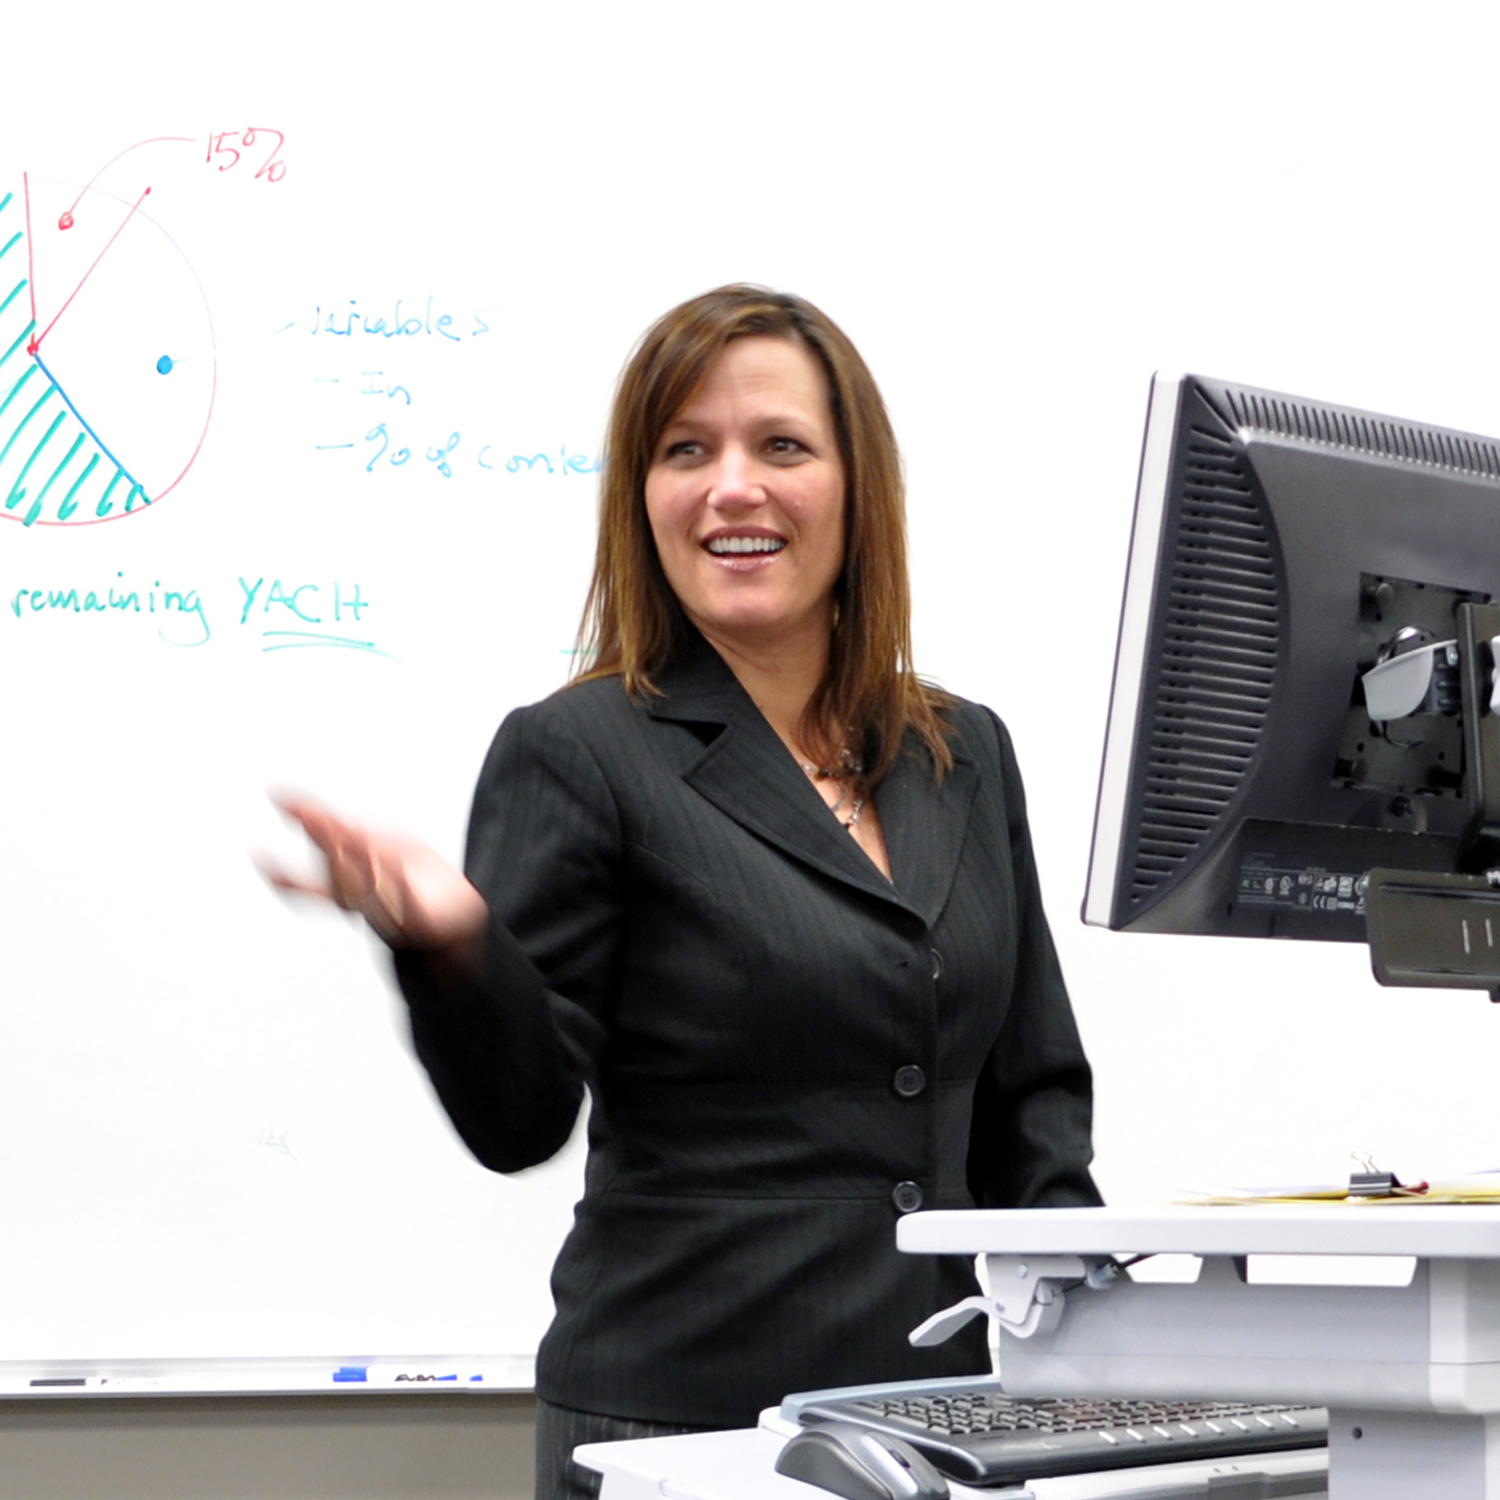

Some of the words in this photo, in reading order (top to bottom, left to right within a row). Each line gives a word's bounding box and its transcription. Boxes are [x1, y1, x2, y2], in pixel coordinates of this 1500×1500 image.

[206, 127, 287, 183] 15%
[425, 430, 462, 480] of
[11, 570, 212, 647] remaining
[237, 574, 370, 625] YACH
